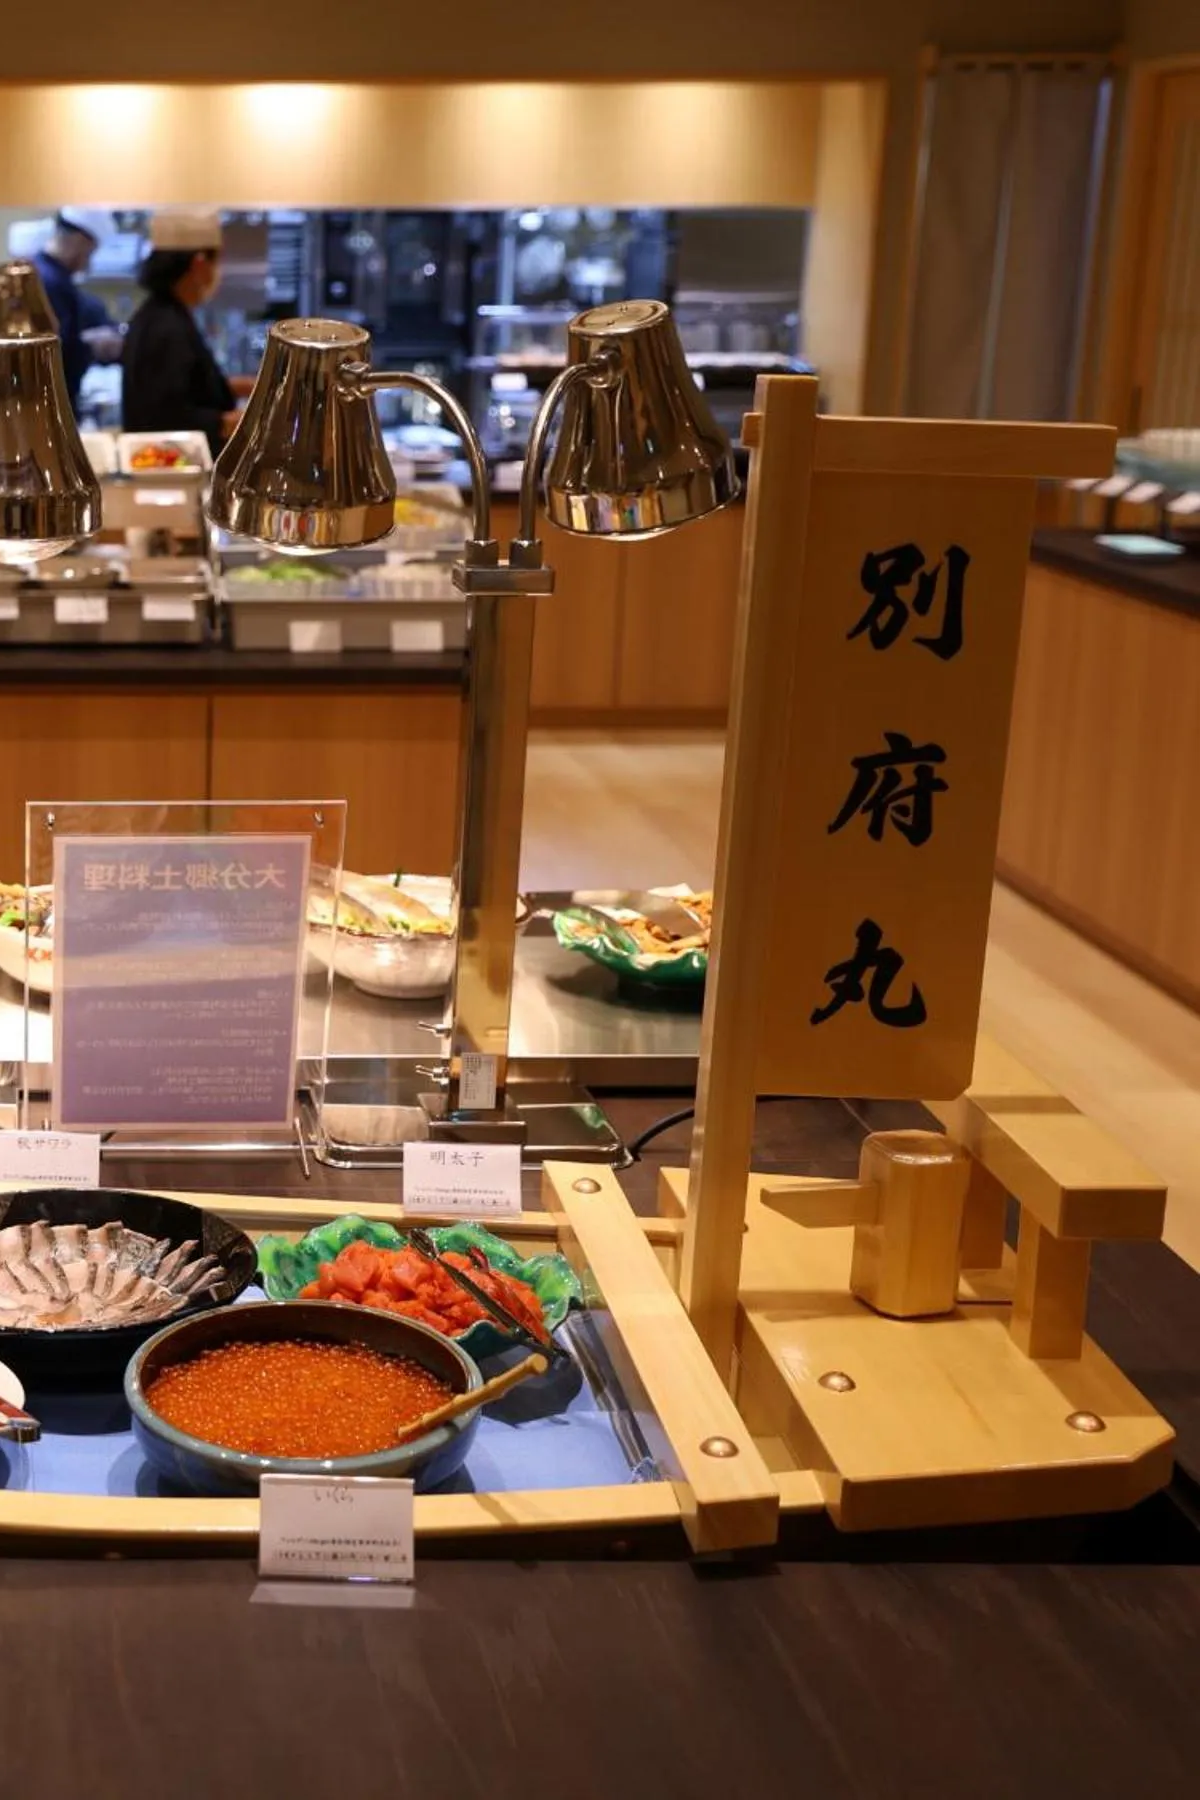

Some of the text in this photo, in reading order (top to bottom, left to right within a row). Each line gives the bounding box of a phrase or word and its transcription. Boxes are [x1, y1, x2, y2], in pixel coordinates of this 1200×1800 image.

[809, 543, 971, 1028] 別府丸
[429, 1150, 484, 1167] 明太子
